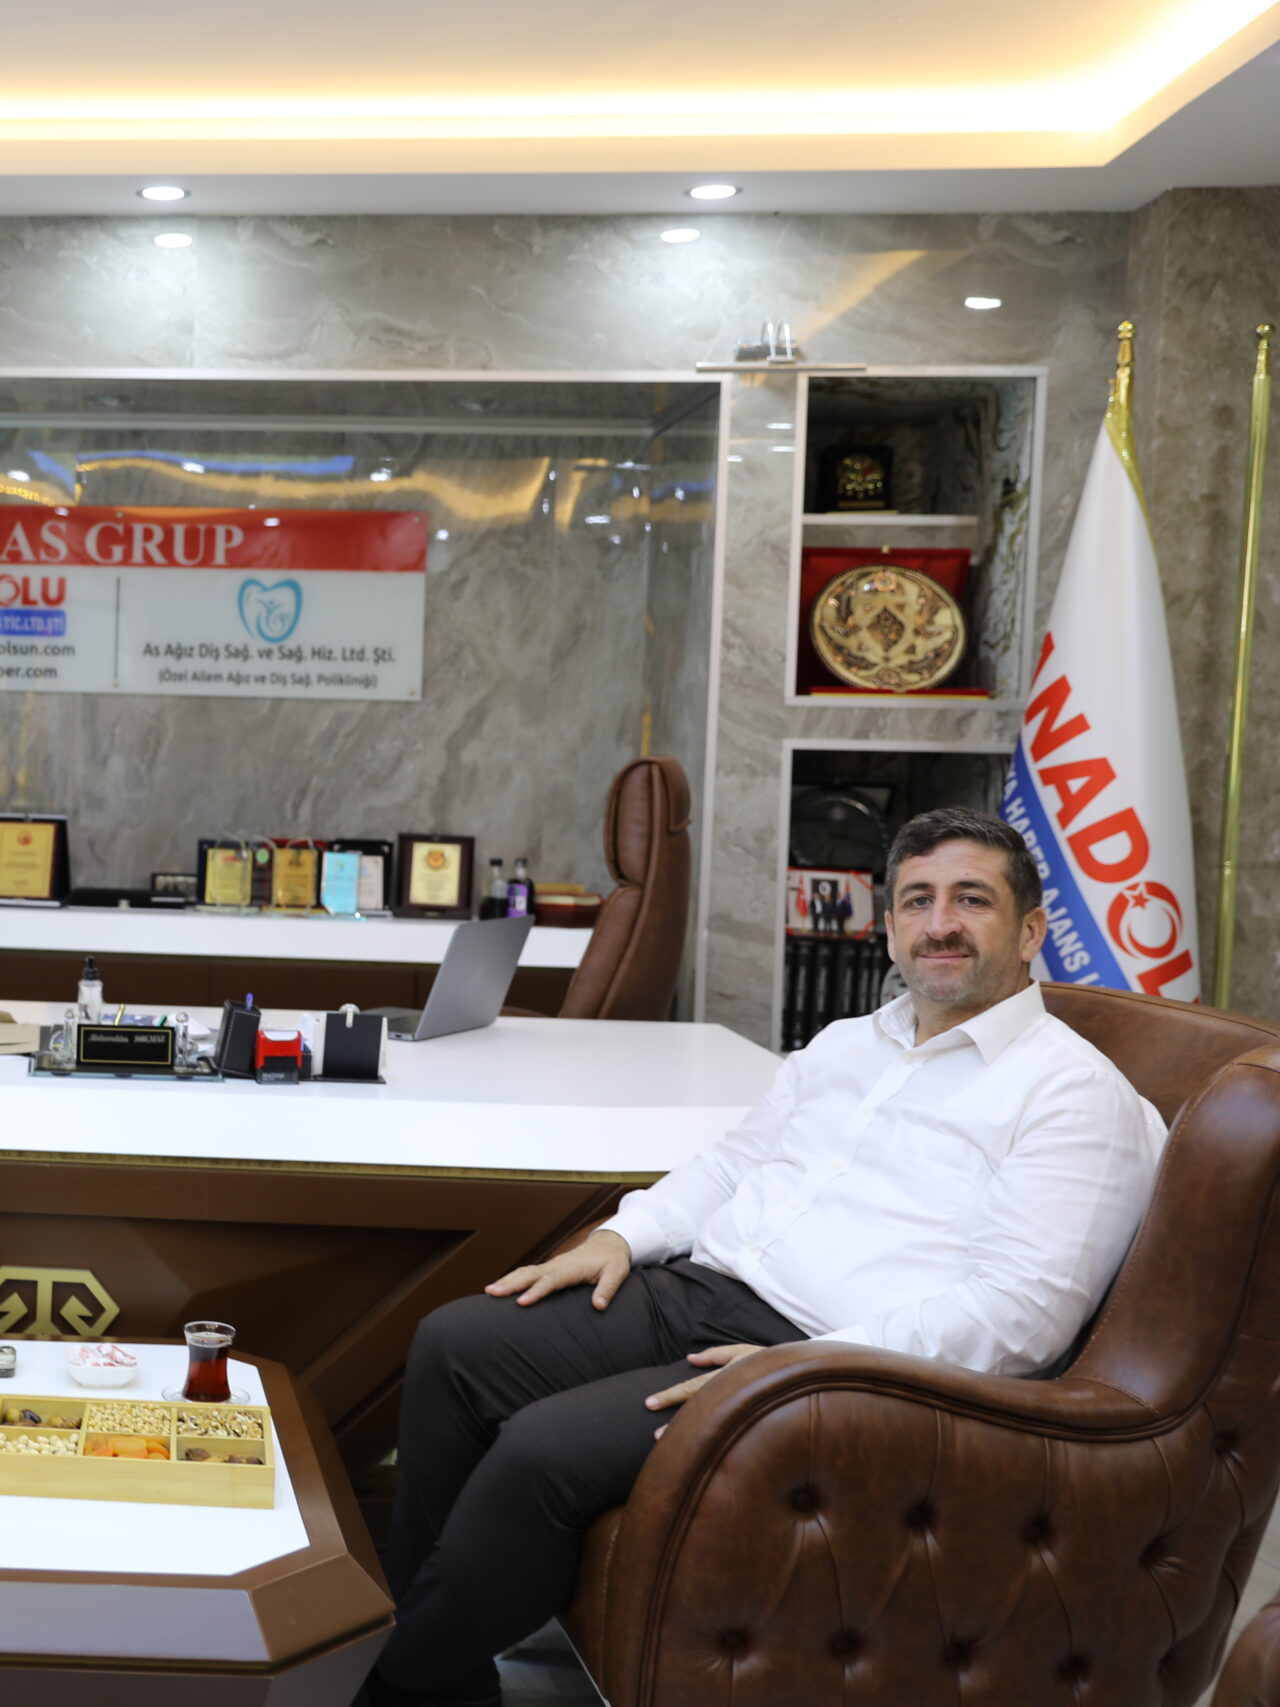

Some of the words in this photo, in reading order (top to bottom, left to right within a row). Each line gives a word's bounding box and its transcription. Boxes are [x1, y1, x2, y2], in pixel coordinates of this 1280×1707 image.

[0, 521, 69, 562] AS
[84, 521, 245, 566] GRUP
[143, 643, 160, 657] As
[164, 643, 195, 661] Ağız
[198, 643, 221, 662] Diş
[257, 648, 274, 659] ve
[341, 646, 370, 662] Ltd.
[253, 674, 267, 684] ve
[1024, 631, 1201, 1004] NADOL
